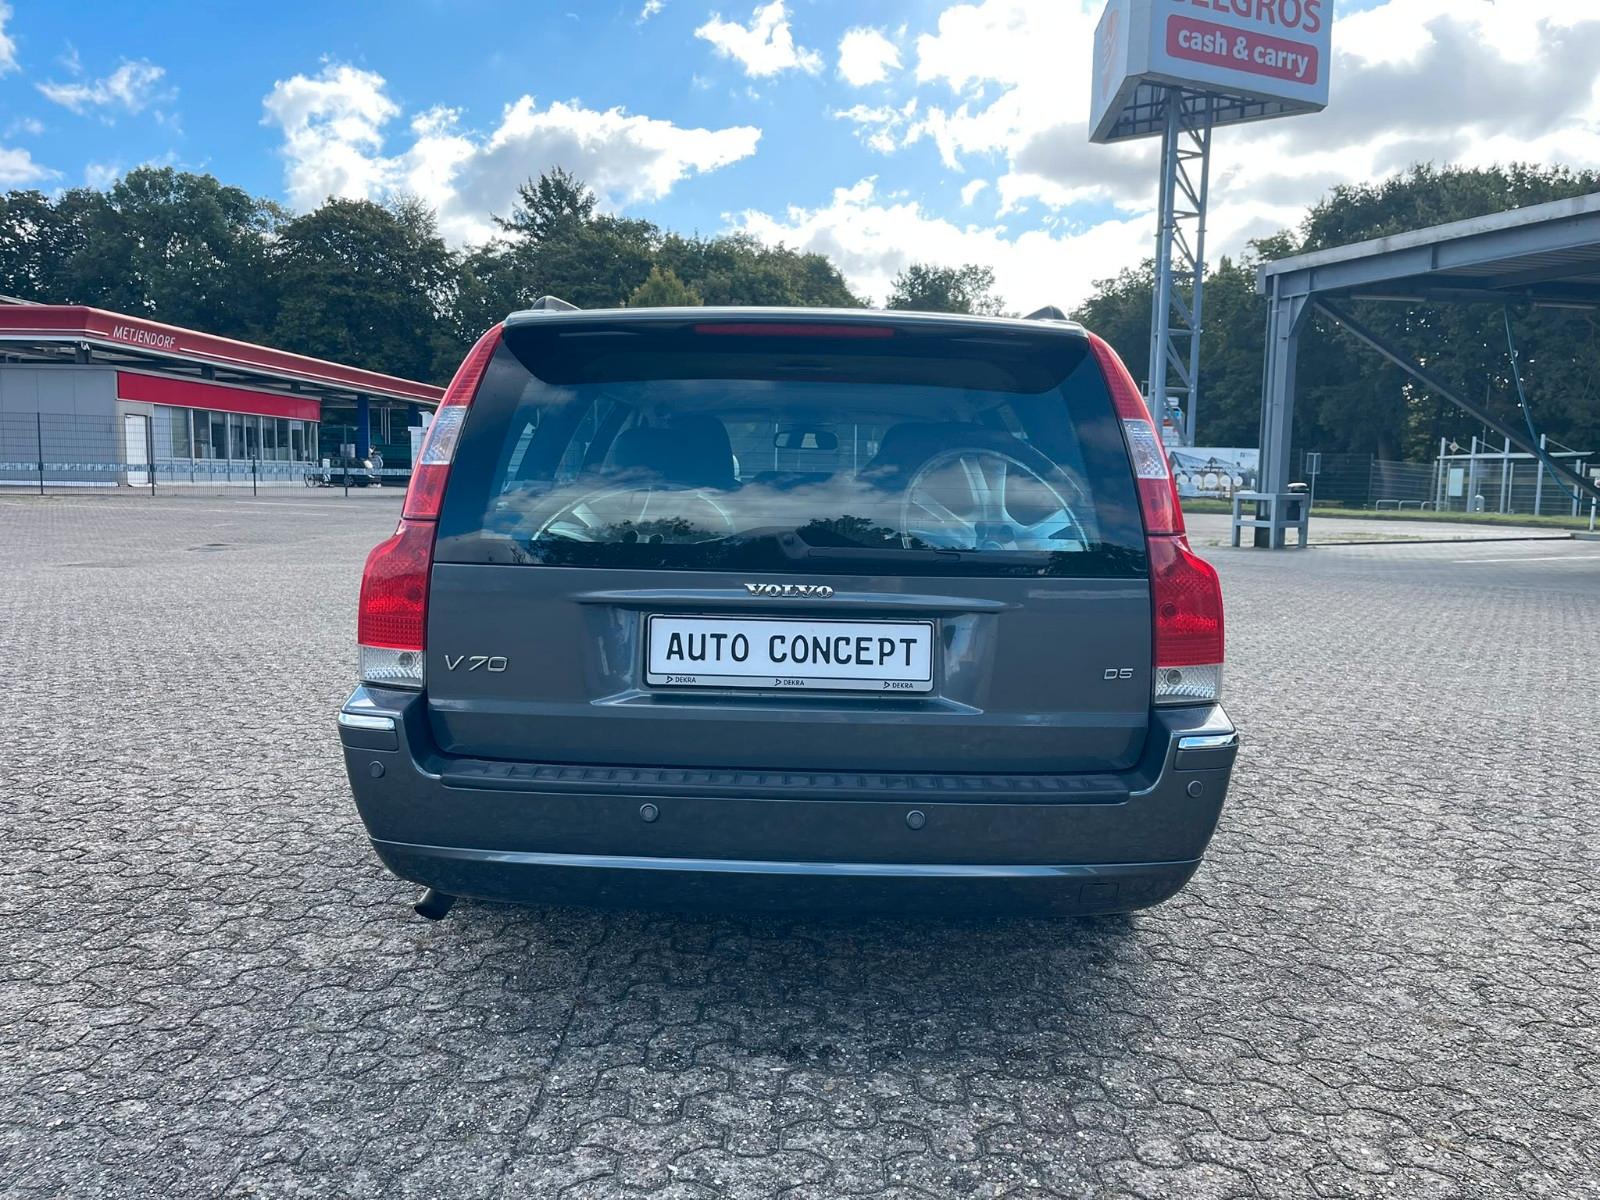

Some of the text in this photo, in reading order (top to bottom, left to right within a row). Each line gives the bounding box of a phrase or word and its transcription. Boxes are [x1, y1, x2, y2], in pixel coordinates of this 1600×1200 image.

[1178, 29, 1309, 78] cash & carry
[113, 325, 176, 349] METJENDORF
[744, 583, 835, 599] VOLVO
[666, 632, 918, 667] AUTO CONCEPT
[674, 676, 697, 684] DEKRA
[1104, 668, 1134, 680] D5
[783, 679, 805, 687] DEKRA
[892, 682, 914, 690] DEKRA
